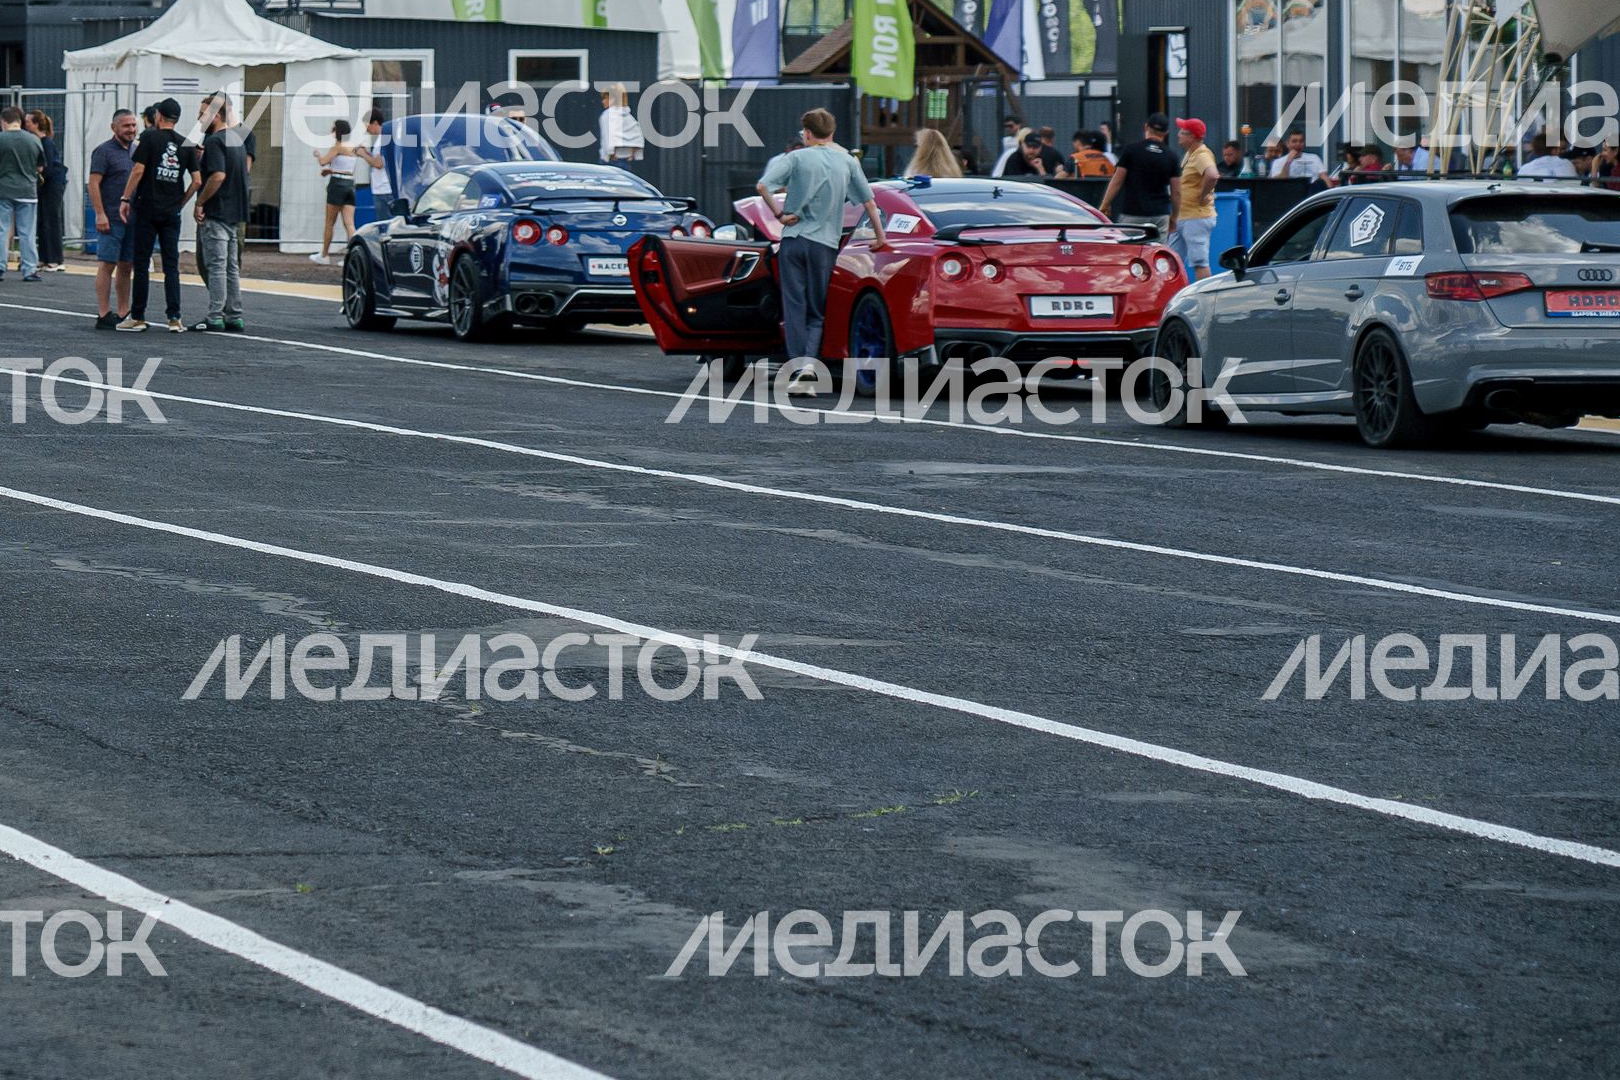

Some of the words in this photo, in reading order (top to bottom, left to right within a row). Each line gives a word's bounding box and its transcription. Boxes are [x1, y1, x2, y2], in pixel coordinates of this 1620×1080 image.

[869, 15, 900, 79] МОЯ
[156, 166, 180, 178] TOYS
[1398, 261, 1414, 271] ВТБ
[1051, 301, 1095, 311] RDRC
